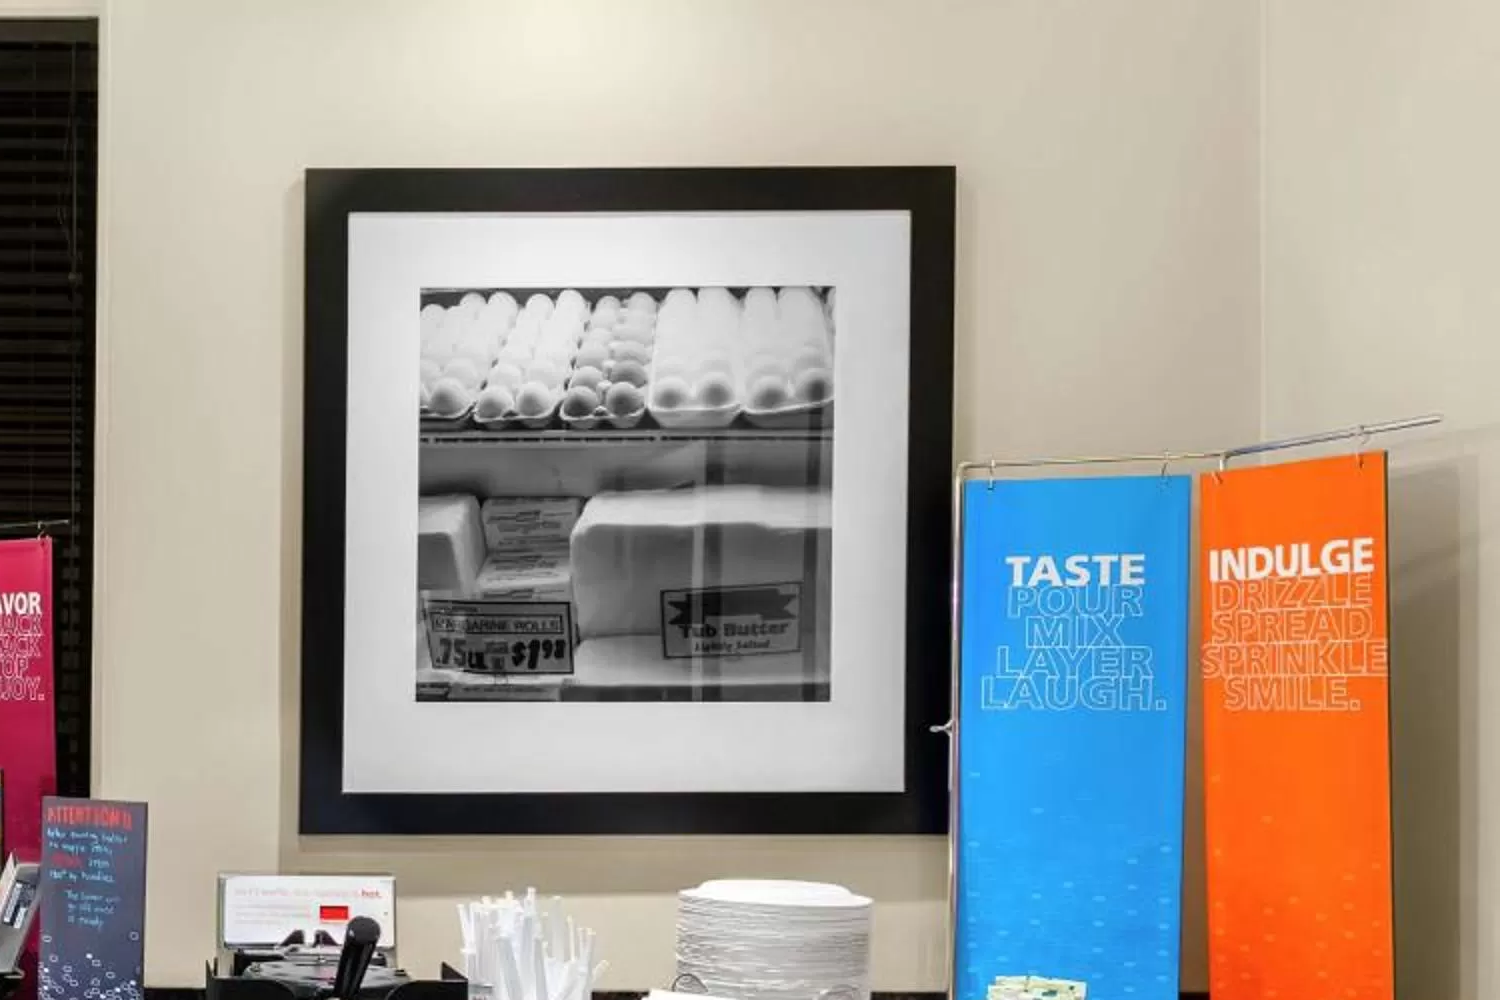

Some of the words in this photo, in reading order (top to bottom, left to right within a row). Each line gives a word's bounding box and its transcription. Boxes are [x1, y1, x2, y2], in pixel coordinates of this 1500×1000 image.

[1005, 554, 1145, 587] TASTE
[1209, 538, 1374, 582] INDULGE
[1007, 584, 1143, 618] POUR
[1212, 574, 1372, 612] DRIZZLE
[723, 622, 789, 637] Butter
[1026, 615, 1124, 648] MIX
[1212, 608, 1372, 646] SPREAD
[996, 645, 1153, 678] LAYER
[1202, 638, 1388, 679] SPRINKLE
[981, 676, 1167, 711] LAUGH.
[1224, 675, 1361, 712] SMILE.
